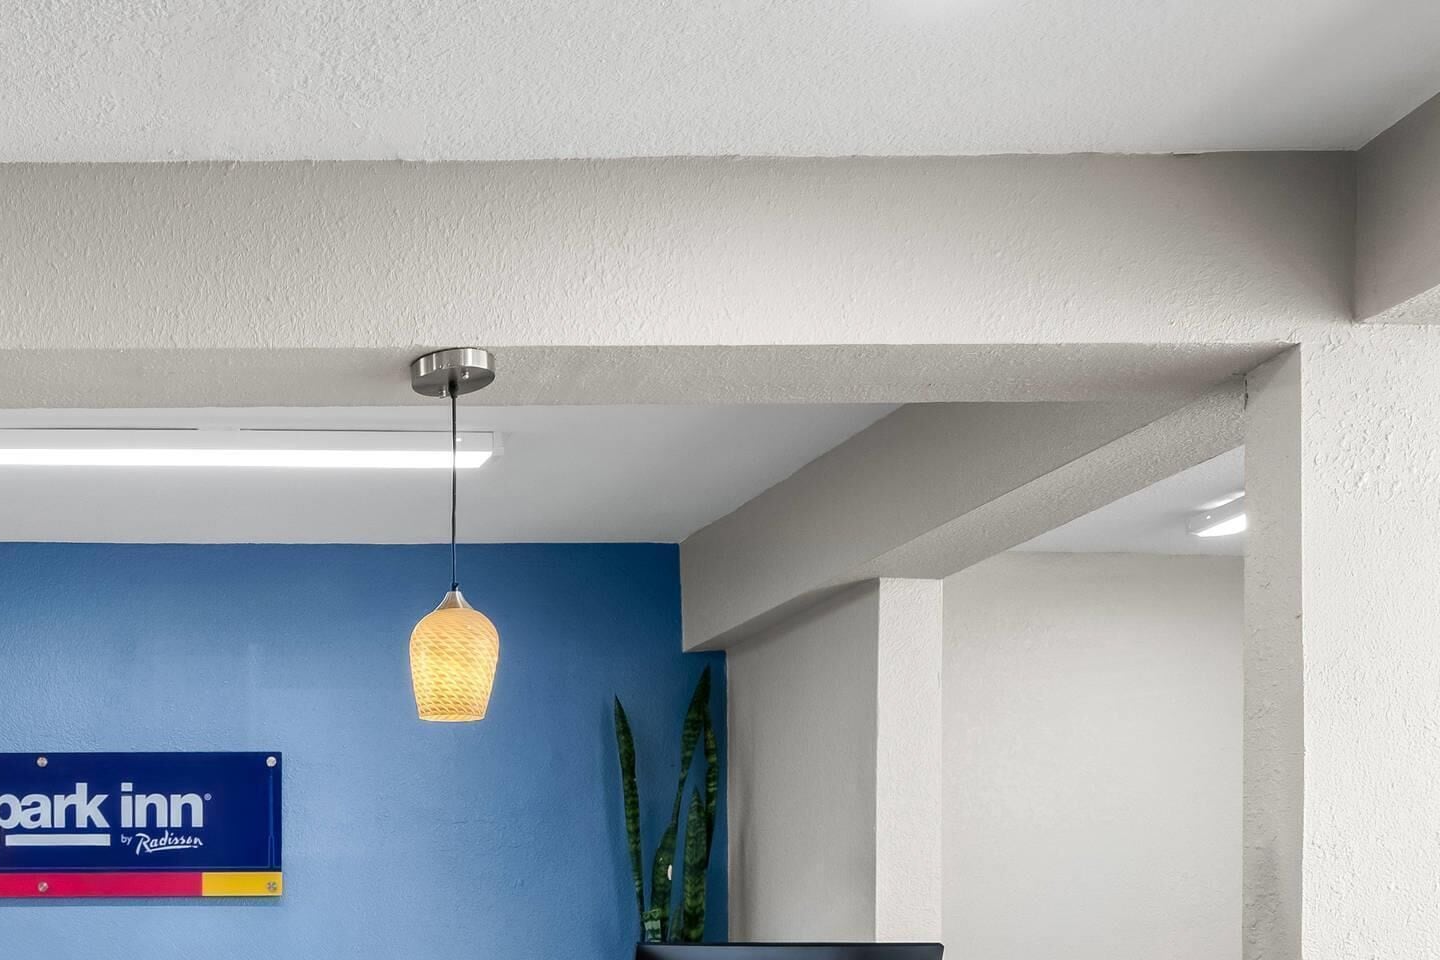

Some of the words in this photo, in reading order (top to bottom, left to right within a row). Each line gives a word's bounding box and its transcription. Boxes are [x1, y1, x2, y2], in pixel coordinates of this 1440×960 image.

[120, 782, 204, 828] inn
[120, 833, 133, 846] by
[135, 829, 204, 856] Radisson
